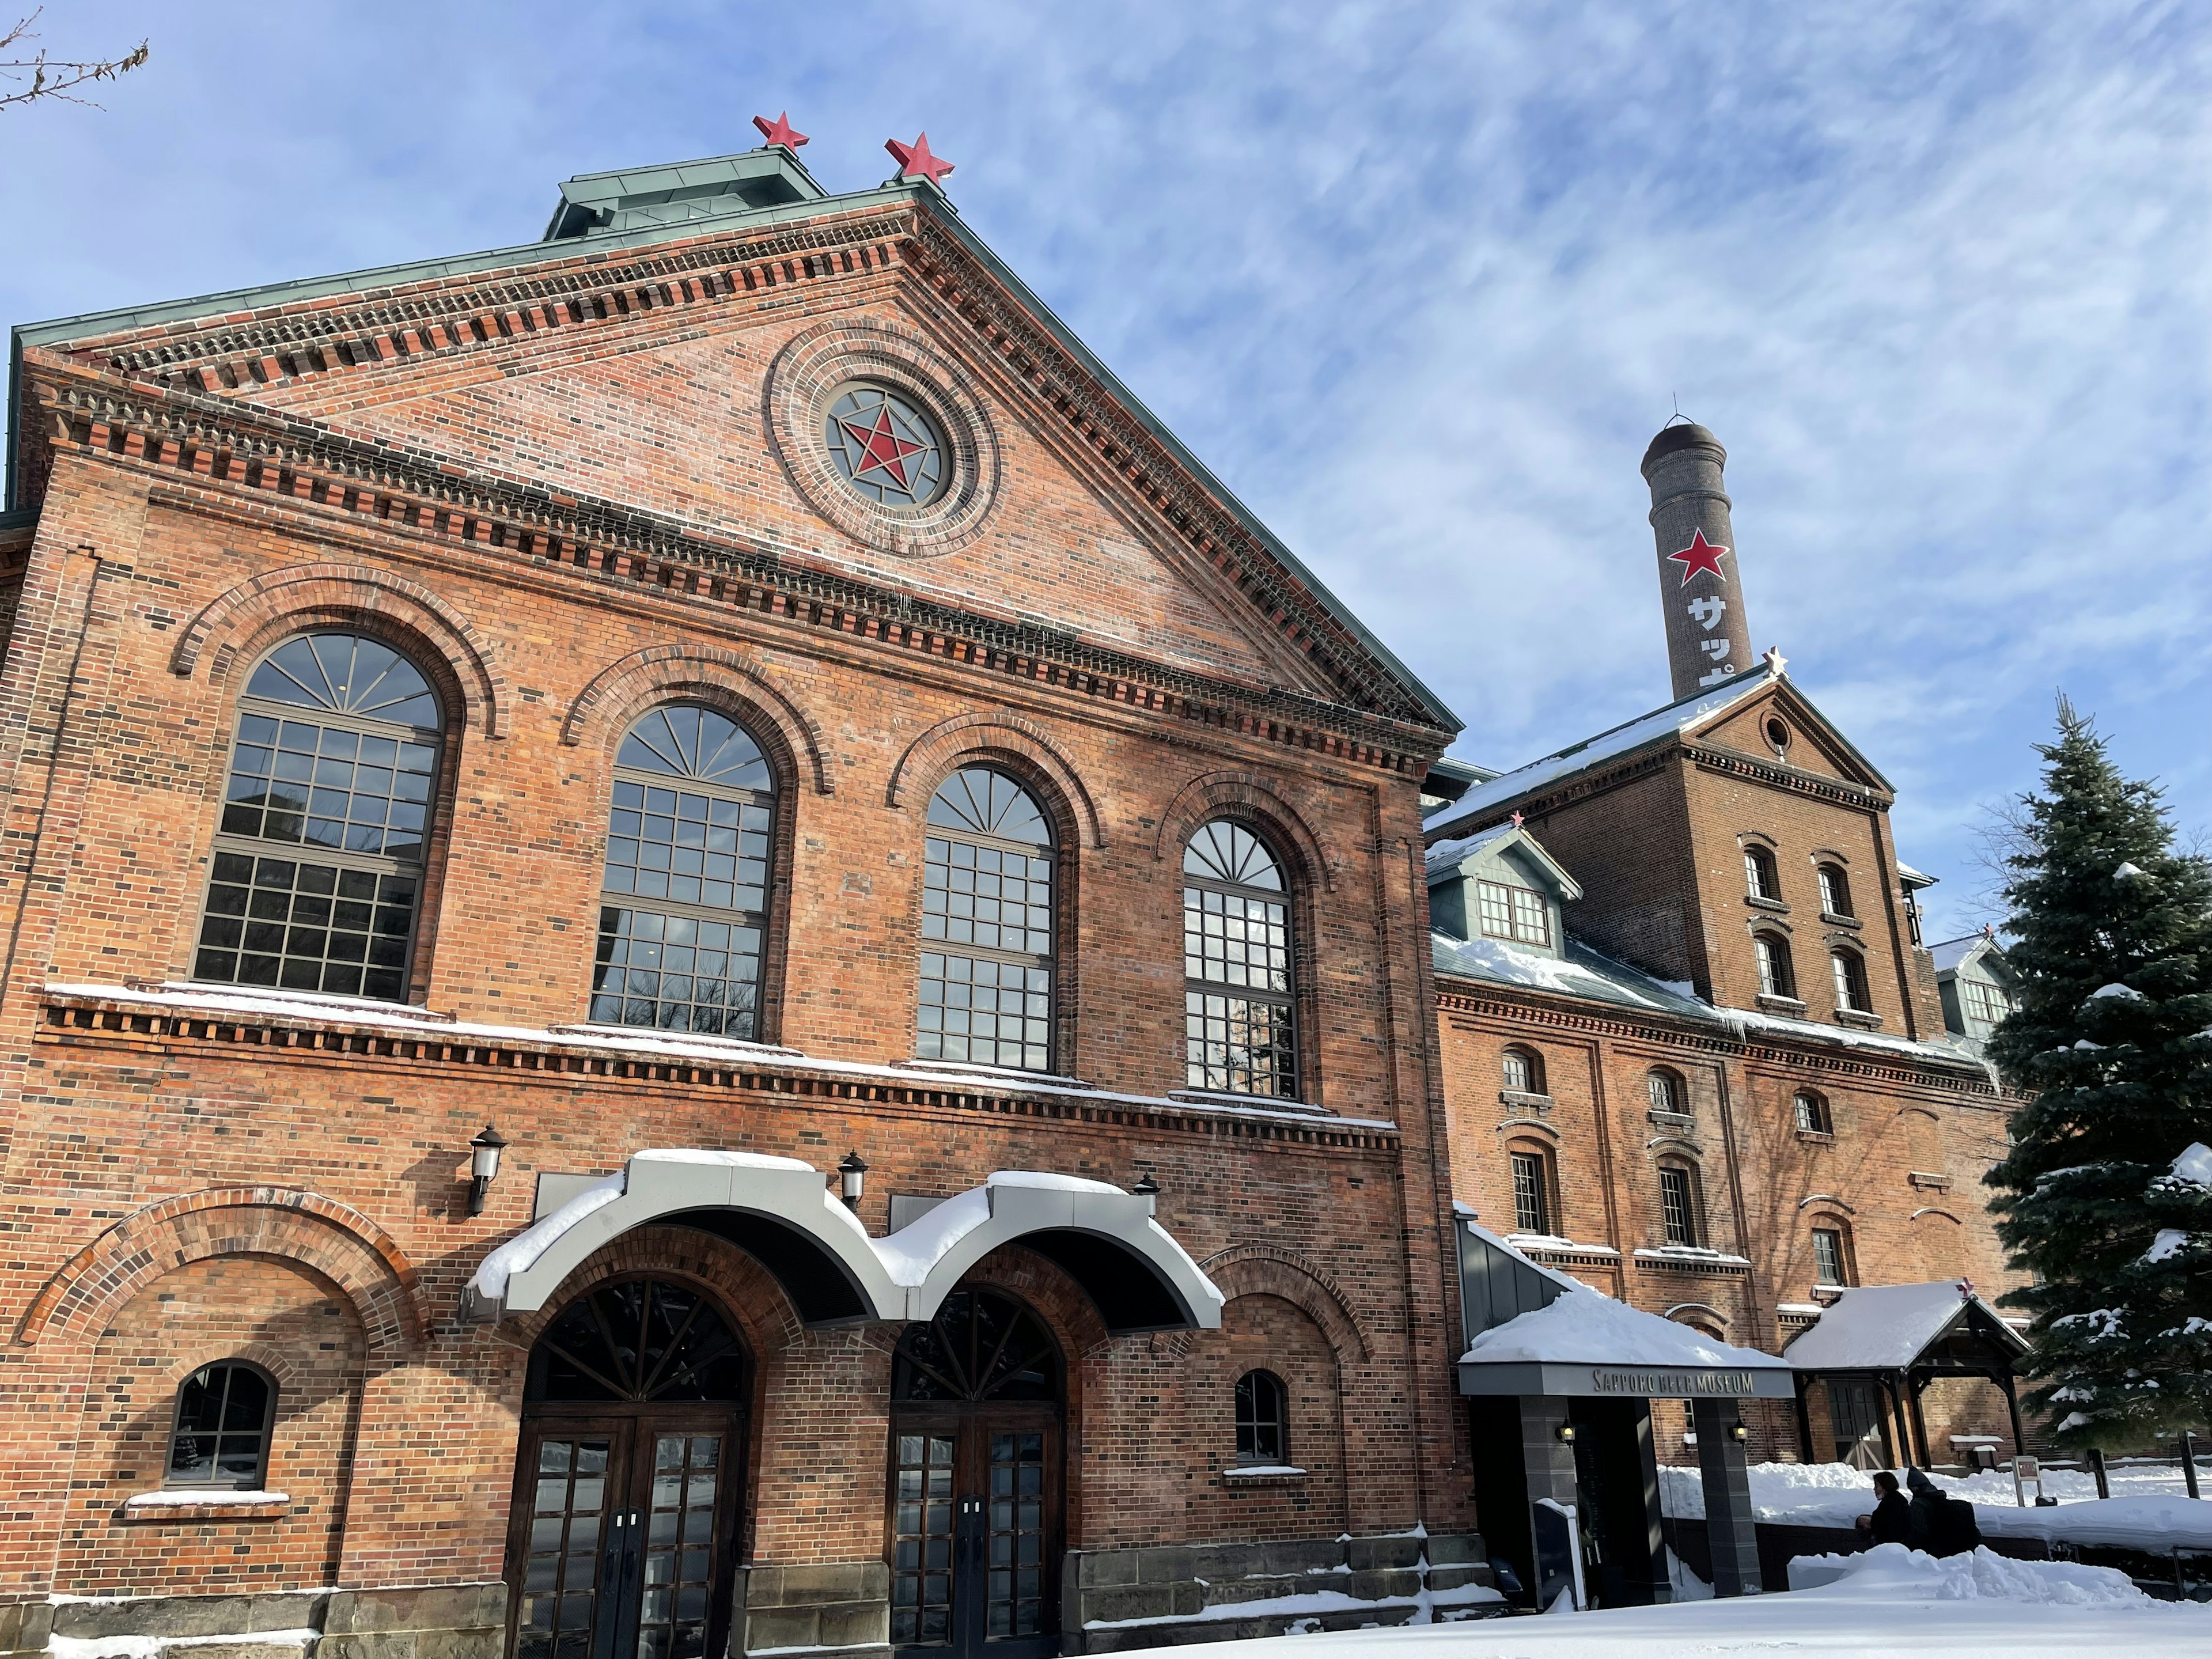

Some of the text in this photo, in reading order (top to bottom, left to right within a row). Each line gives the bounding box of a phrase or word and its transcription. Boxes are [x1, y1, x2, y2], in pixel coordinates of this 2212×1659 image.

[1593, 1369, 1754, 1393] SAPPORO BEER MUSEUM
